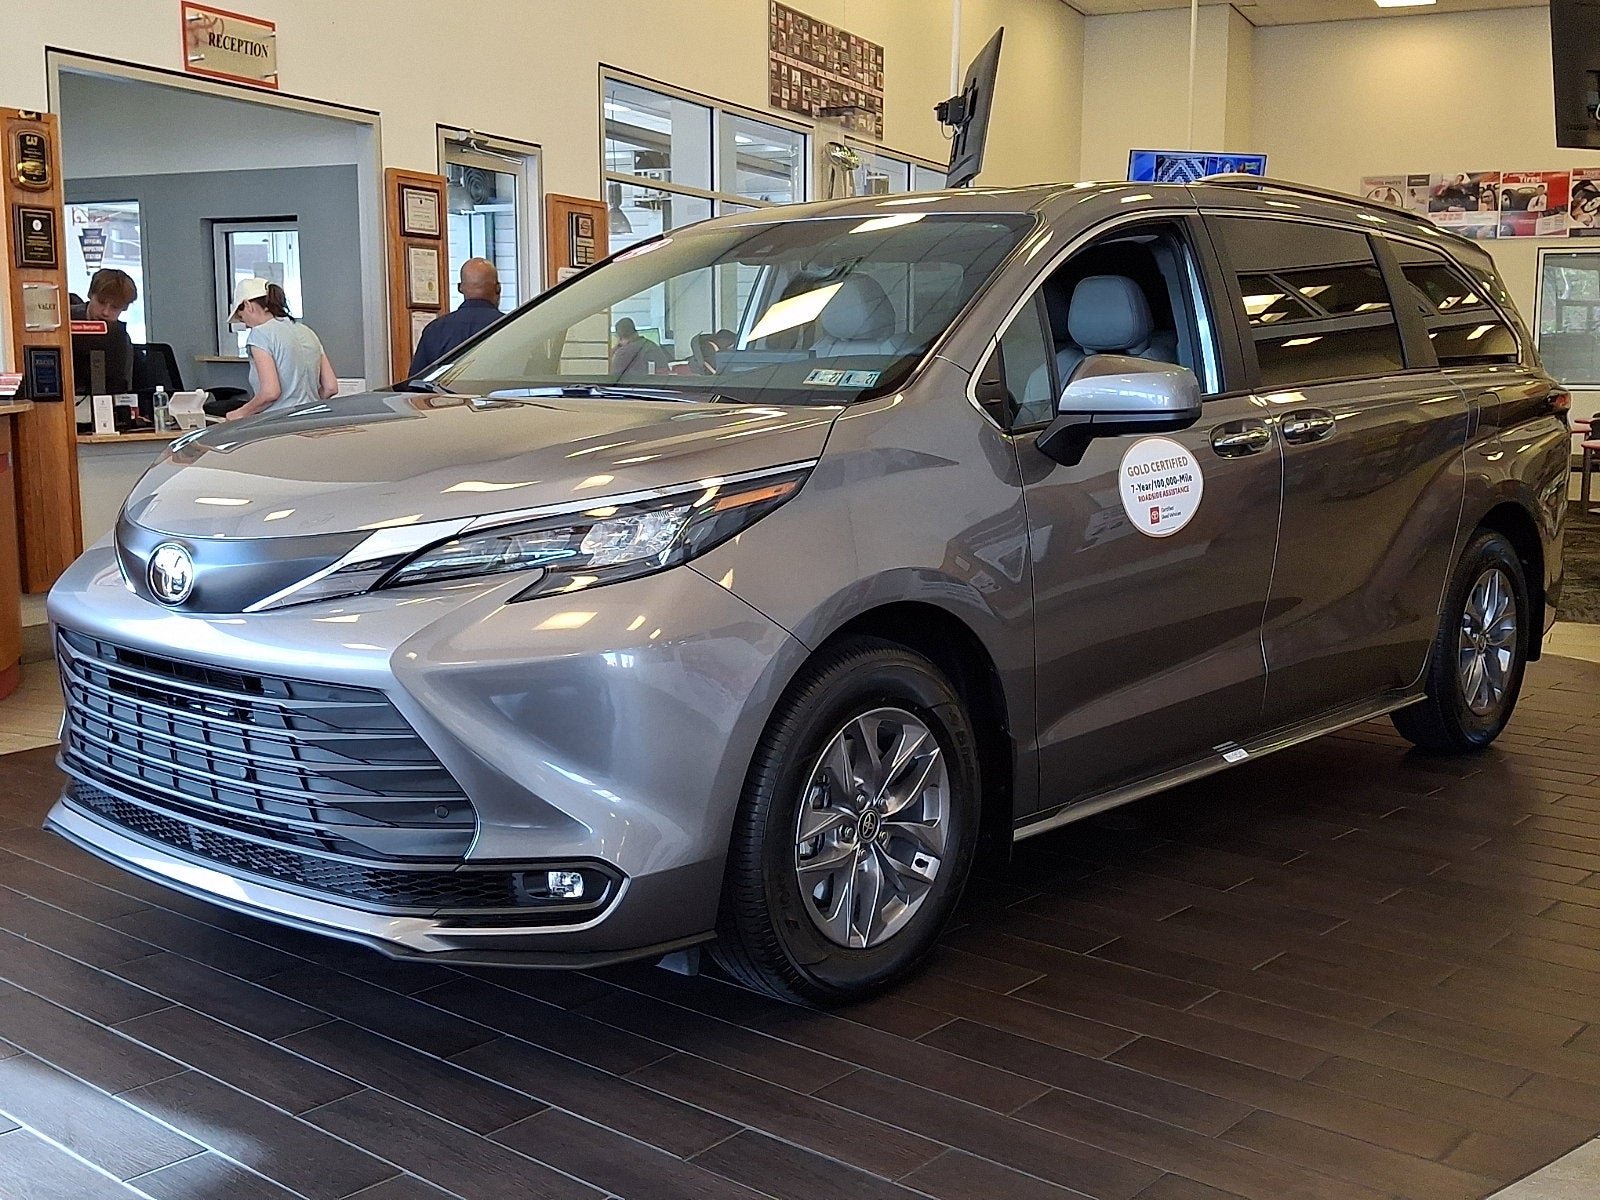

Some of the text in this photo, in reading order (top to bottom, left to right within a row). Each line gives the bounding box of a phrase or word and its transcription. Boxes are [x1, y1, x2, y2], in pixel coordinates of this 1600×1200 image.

[208, 32, 268, 58] RECEPTION
[1127, 456, 1188, 477] GOLD CERTIFIED
[1130, 473, 1193, 493] 7-Year/100,000-Mile
[1138, 485, 1190, 503] ROADSIDE ASSISTANCE
